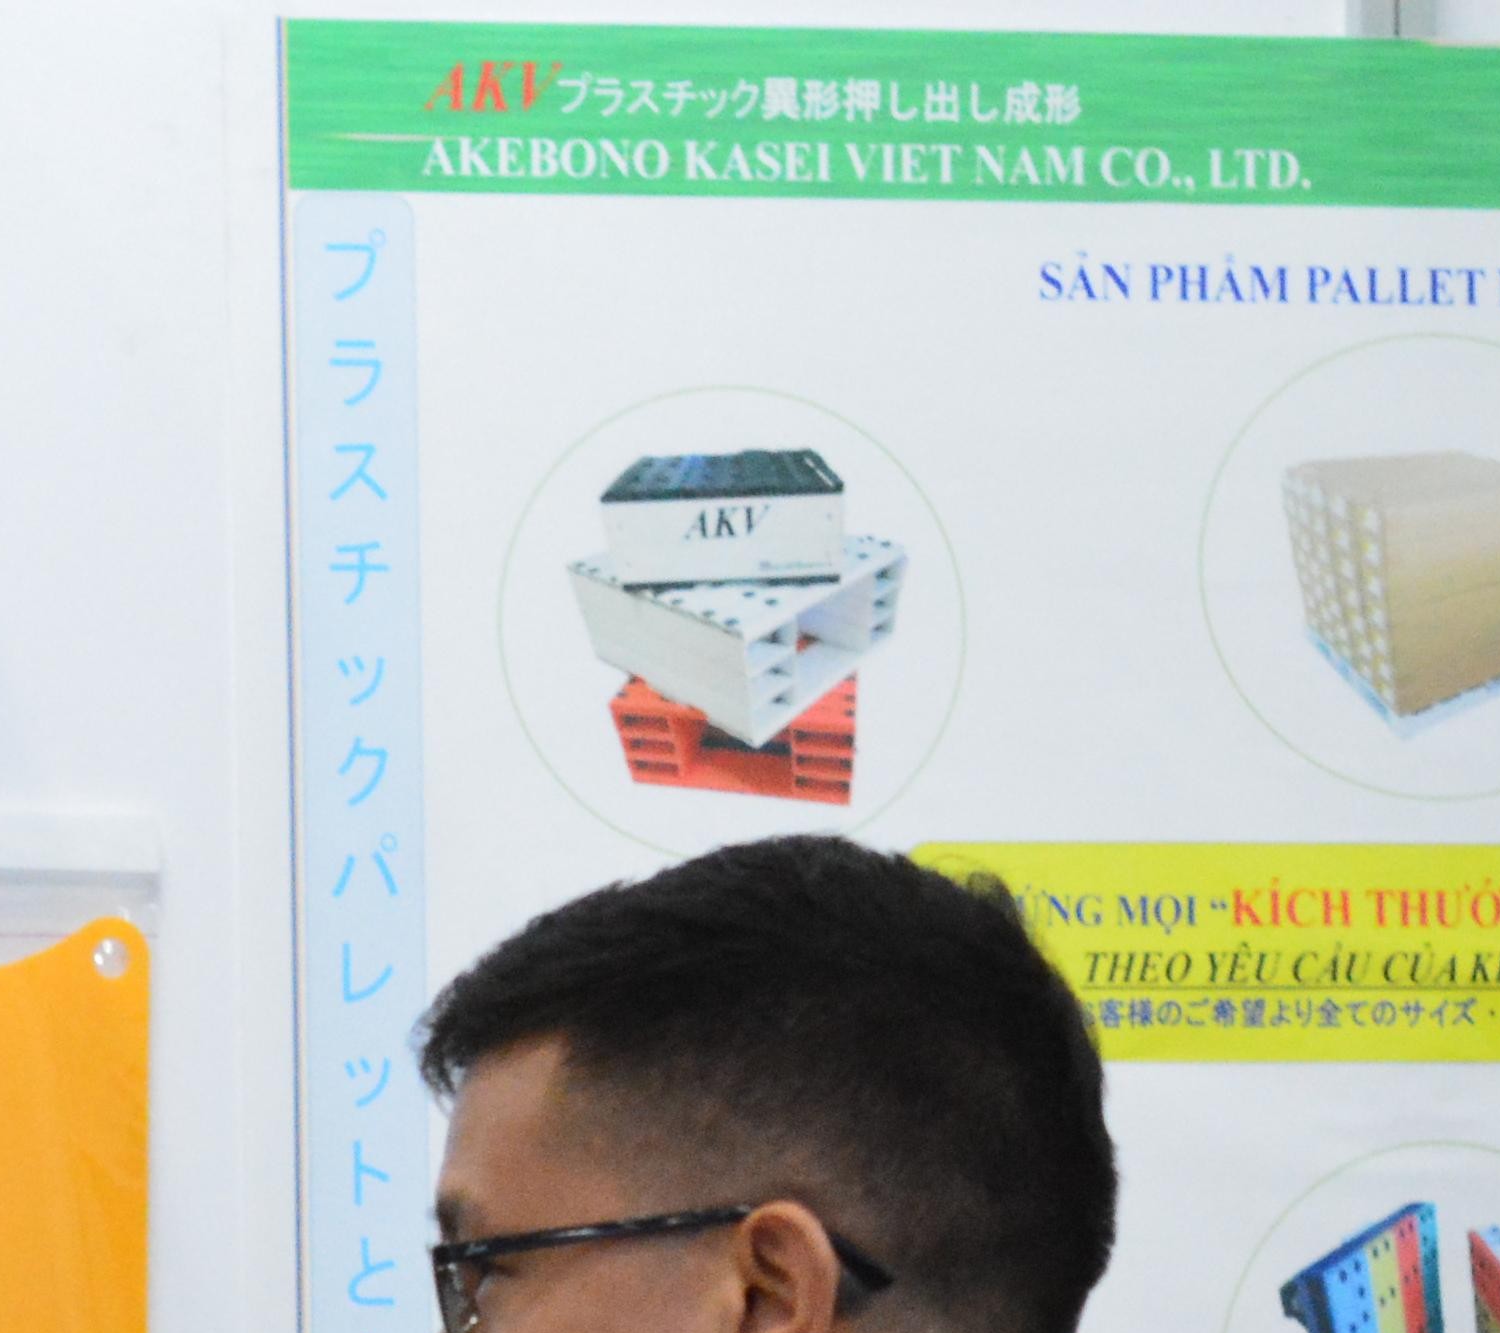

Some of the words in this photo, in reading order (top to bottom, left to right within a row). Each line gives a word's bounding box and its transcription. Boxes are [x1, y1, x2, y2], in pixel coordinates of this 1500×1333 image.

[424, 60, 563, 112] AKV
[557, 71, 1082, 125] プラスチック異形押し出し成形
[422, 136, 670, 180] AKEBONO
[685, 139, 831, 183] KASEI
[845, 142, 962, 184] VIET
[973, 145, 1087, 187] NAM
[1100, 147, 1197, 194] CO.,
[1210, 149, 1312, 191] LTD.
[1039, 250, 1132, 303] SẢN
[1306, 264, 1486, 307] PALLET
[683, 505, 771, 540] AKV
[1117, 893, 1197, 936] MỌI
[1210, 876, 1351, 928] “KÍCH
[1084, 950, 1192, 985] THEO
[1208, 941, 1279, 984] YÊU
[1381, 940, 1458, 985] CỦA
